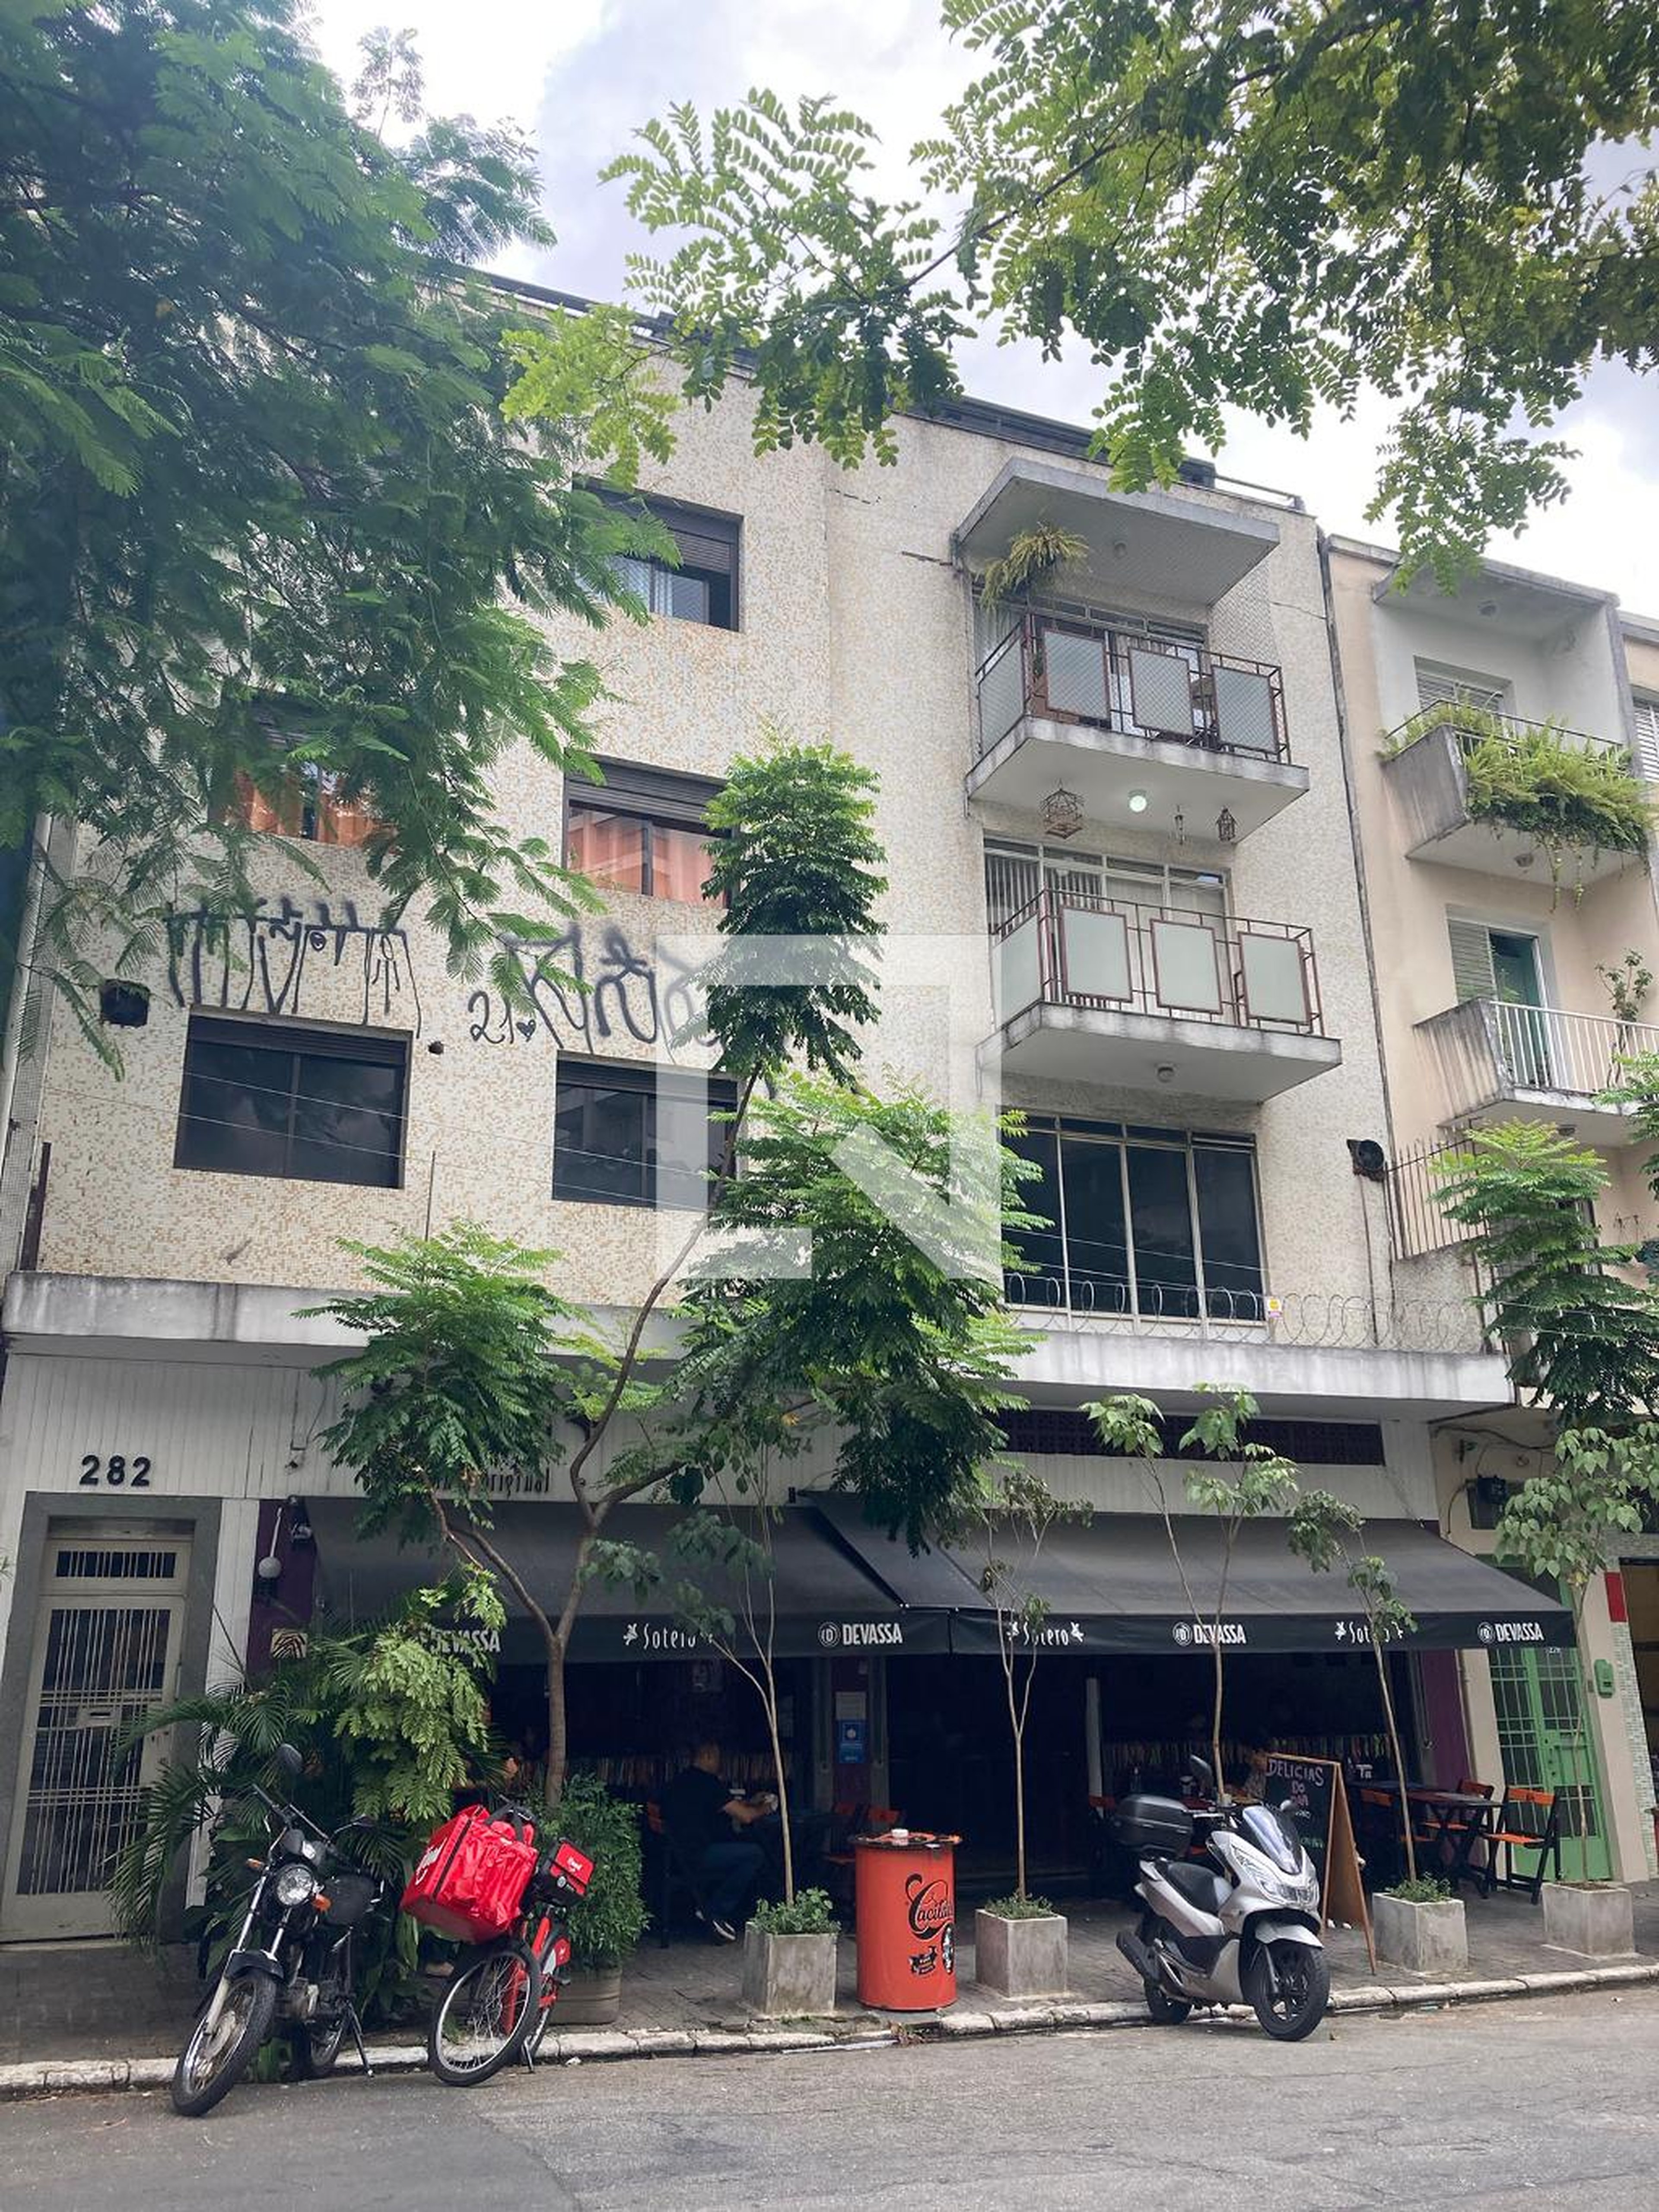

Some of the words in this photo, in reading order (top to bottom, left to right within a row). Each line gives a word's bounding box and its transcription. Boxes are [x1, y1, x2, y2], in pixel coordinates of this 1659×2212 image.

[79, 1455, 151, 1486] 282
[842, 1623, 903, 1645] DEVASSA
[1193, 1624, 1247, 1644] DEVASSA
[1349, 1621, 1390, 1643] Soto
[1494, 1622, 1545, 1642] DEVASSA
[1265, 1759, 1324, 1787] DELICIAS
